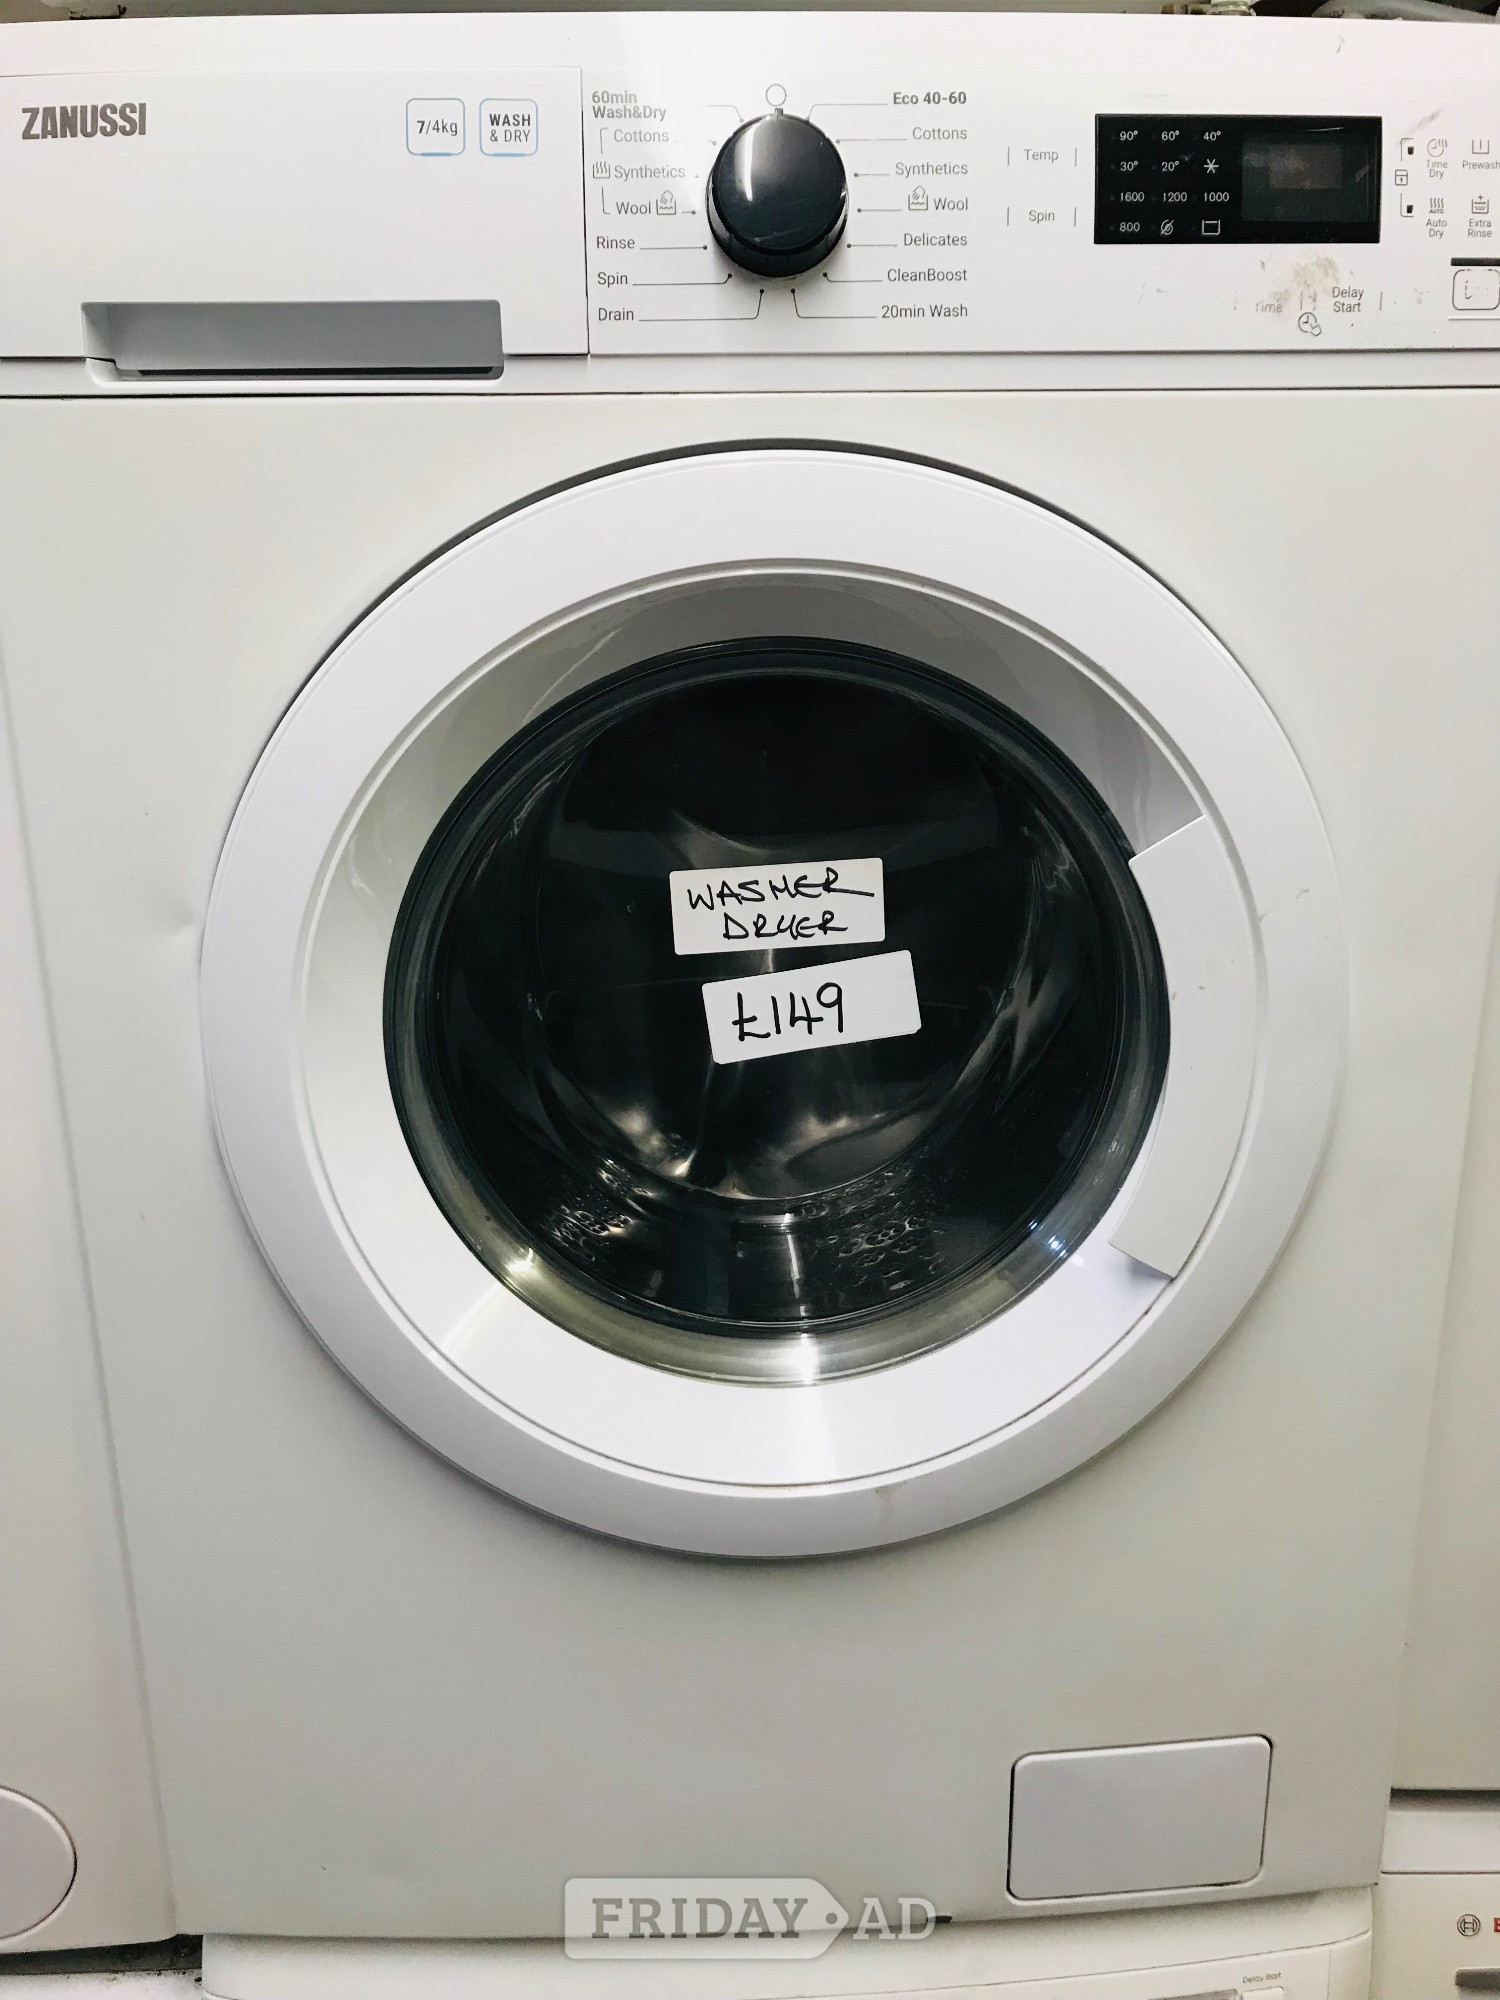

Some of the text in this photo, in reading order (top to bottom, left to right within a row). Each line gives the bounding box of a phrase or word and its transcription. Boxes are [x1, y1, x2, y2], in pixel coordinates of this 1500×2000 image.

[591, 90, 638, 104] 60min
[892, 91, 968, 105] Eco 40-60
[592, 105, 667, 121] Wash&Dry
[22, 102, 147, 140] ZANUSSI
[489, 113, 531, 127] WASH
[416, 118, 458, 137] 7/4kg
[911, 127, 968, 140] Cottons
[489, 129, 531, 142] & DRY
[613, 128, 670, 142] Cottons
[1119, 130, 1139, 141] 90°
[1161, 130, 1180, 141] 60°
[1203, 130, 1222, 141] 40°
[1023, 148, 1059, 164] Temp
[895, 162, 968, 177] Synthetics
[1119, 161, 1139, 172] 30°
[1161, 161, 1180, 172] 20°
[1426, 159, 1448, 168] Time
[1462, 159, 1500, 170] Prewash
[613, 164, 686, 179] Synthetics
[1429, 169, 1445, 179] Dry
[1120, 191, 1145, 202] 1600
[1163, 191, 1188, 202] 1200
[1204, 191, 1230, 202] 1000
[615, 201, 651, 215] Wool
[934, 197, 969, 211] Wool
[1028, 208, 1056, 223] Spin
[1119, 221, 1141, 232] 800
[1426, 218, 1448, 228] Auto
[1468, 218, 1492, 228] Extra
[903, 233, 968, 246] Delicates
[1428, 228, 1444, 239] Dry
[1467, 228, 1493, 238] Rinse
[596, 236, 636, 250] Rinse
[597, 271, 629, 286] Spin
[887, 268, 968, 282] CleanBoost
[1332, 286, 1365, 299] Delay
[881, 304, 969, 319] 20min Wash
[1333, 301, 1362, 313] Start
[598, 307, 635, 322] Drain
[687, 866, 875, 911] WASHER
[722, 910, 848, 940] DRYER
[731, 981, 844, 1042] £149
